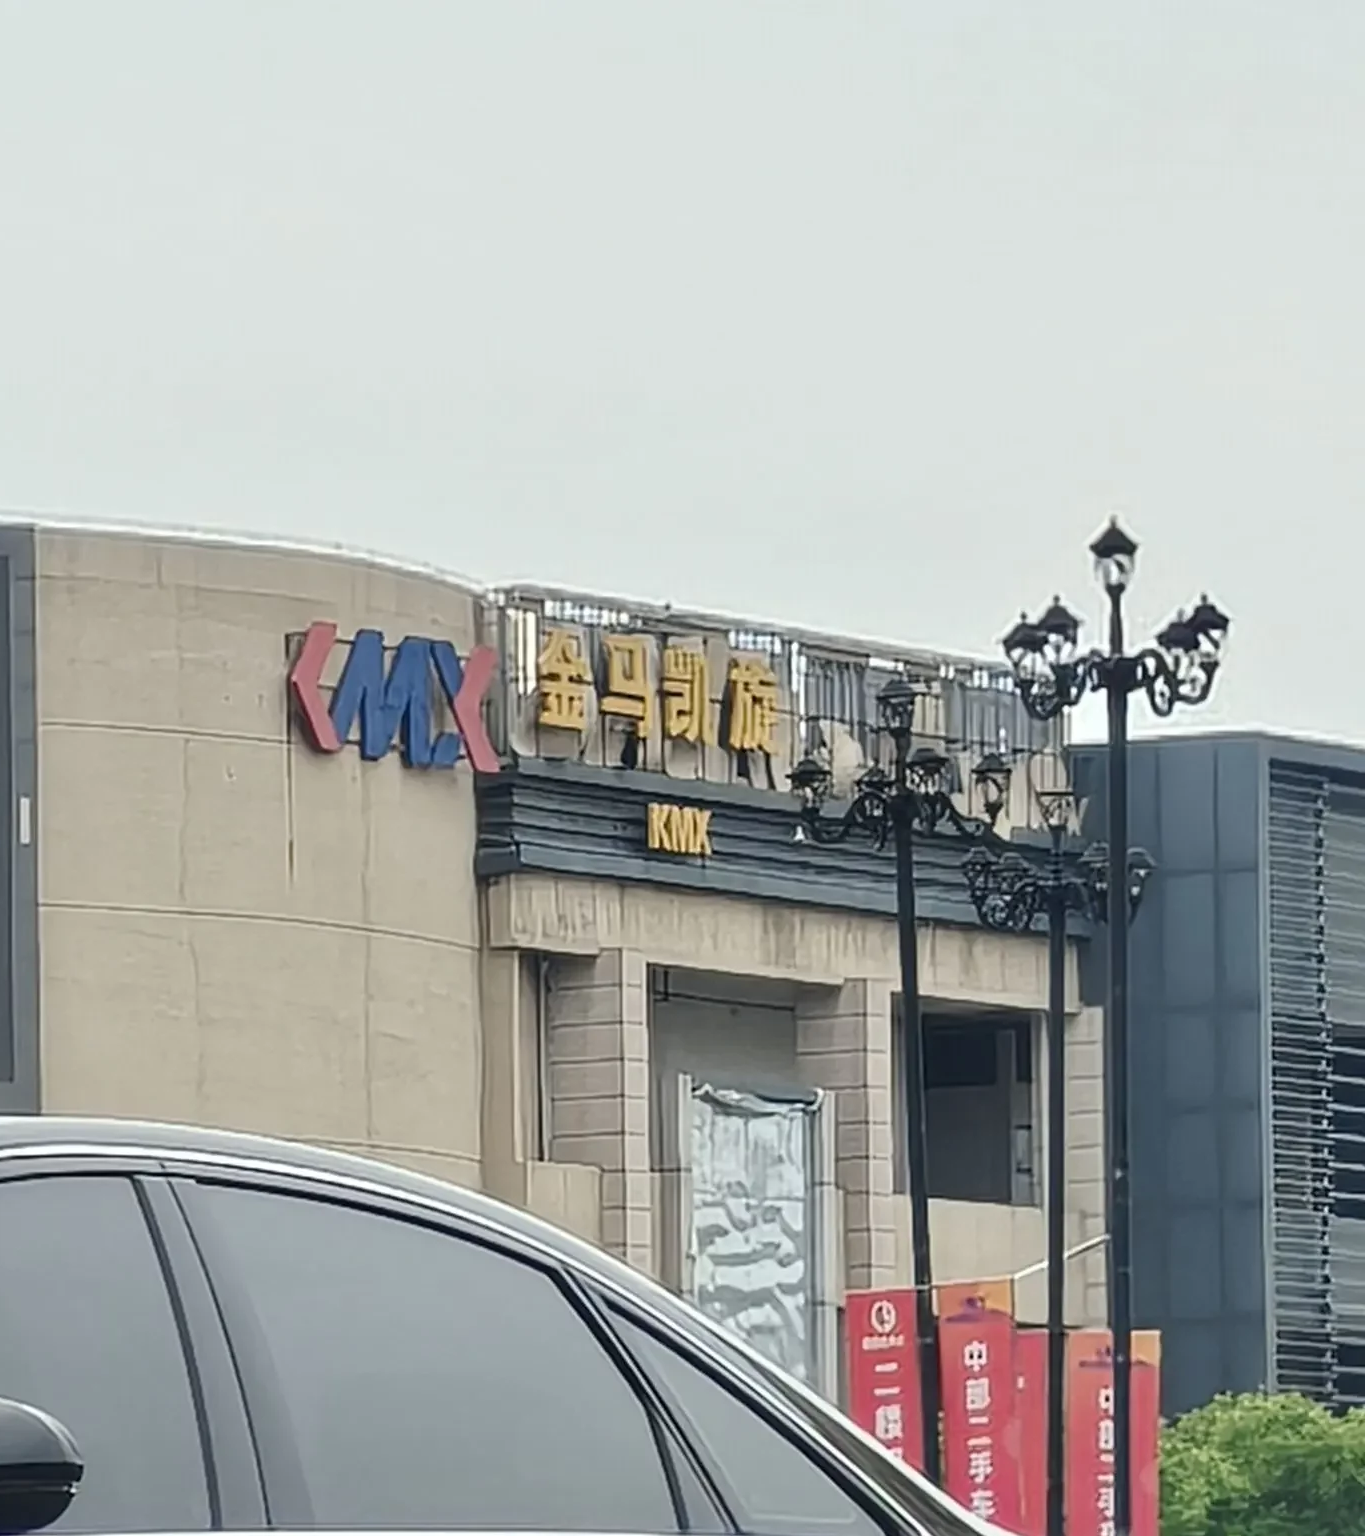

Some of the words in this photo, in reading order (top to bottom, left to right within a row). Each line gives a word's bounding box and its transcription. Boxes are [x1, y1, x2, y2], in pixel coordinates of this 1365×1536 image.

[538, 628, 781, 756] 金马凯旋
[648, 802, 712, 855] KMX
